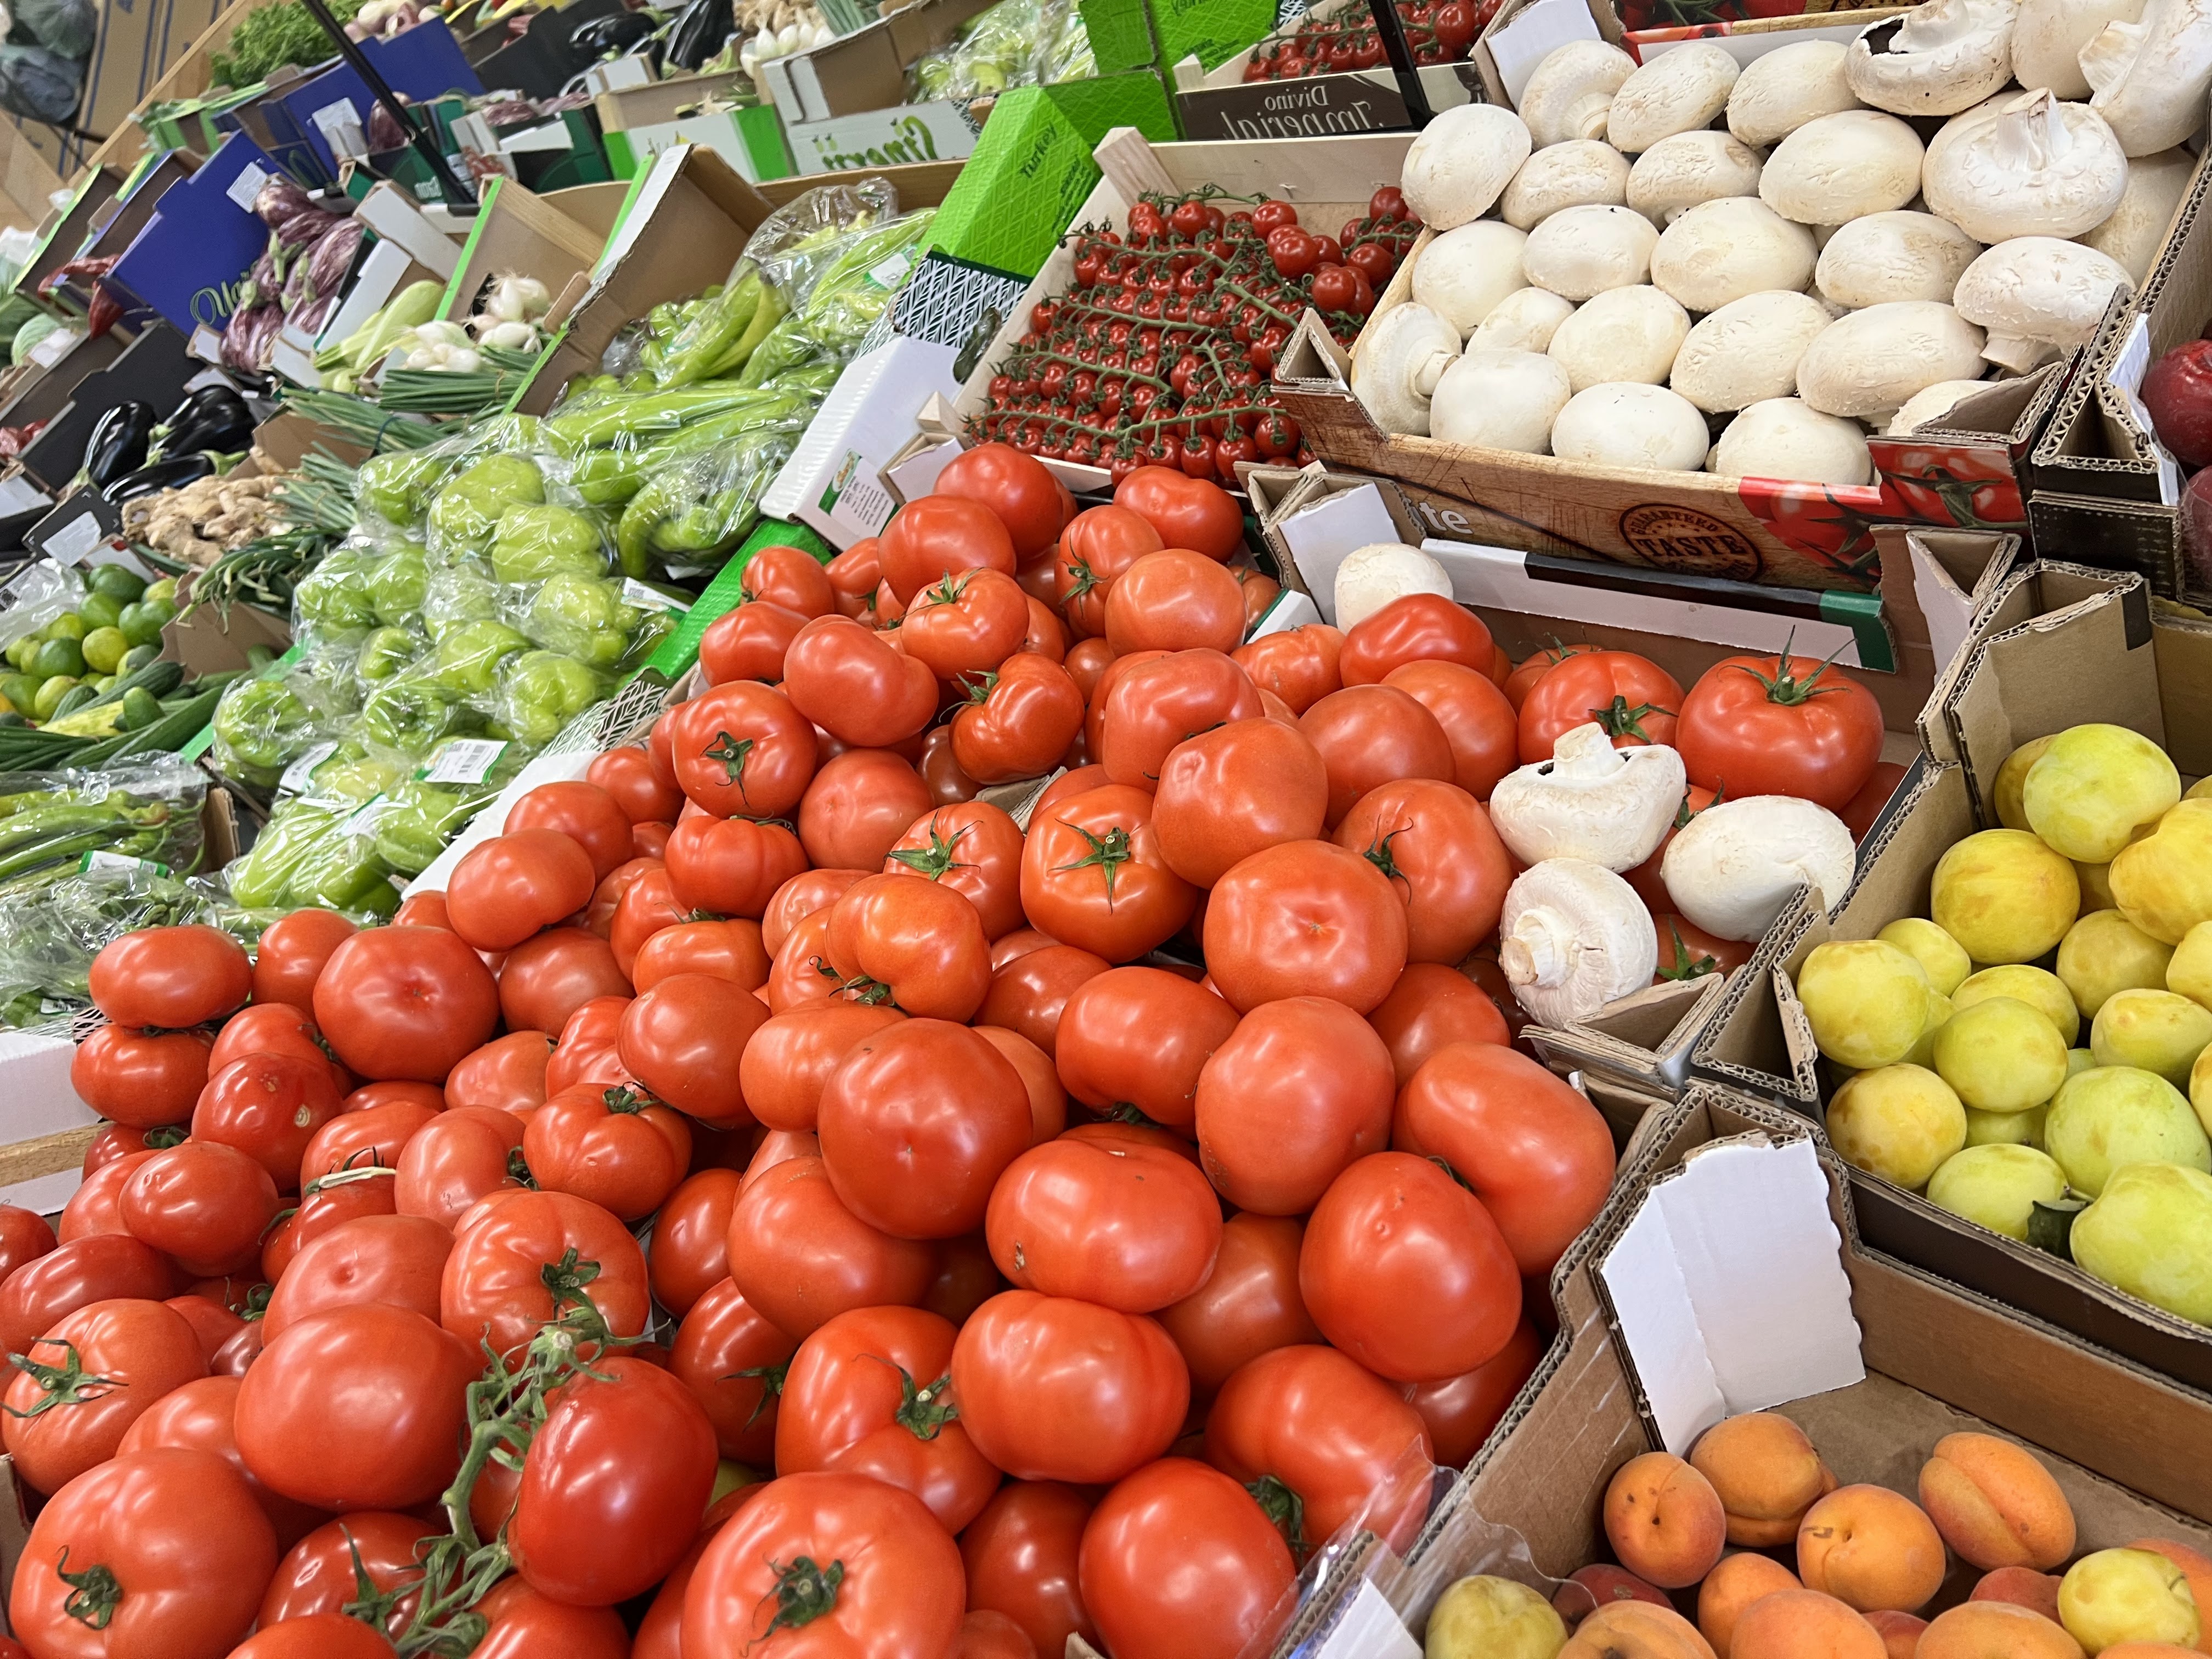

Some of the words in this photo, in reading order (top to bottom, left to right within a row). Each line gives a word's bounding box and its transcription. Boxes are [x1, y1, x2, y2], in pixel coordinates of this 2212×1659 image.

[1019, 120, 1057, 178] Turkey
[1630, 510, 1718, 535] GUARANTEED
[1635, 535, 1747, 556] TASTE
